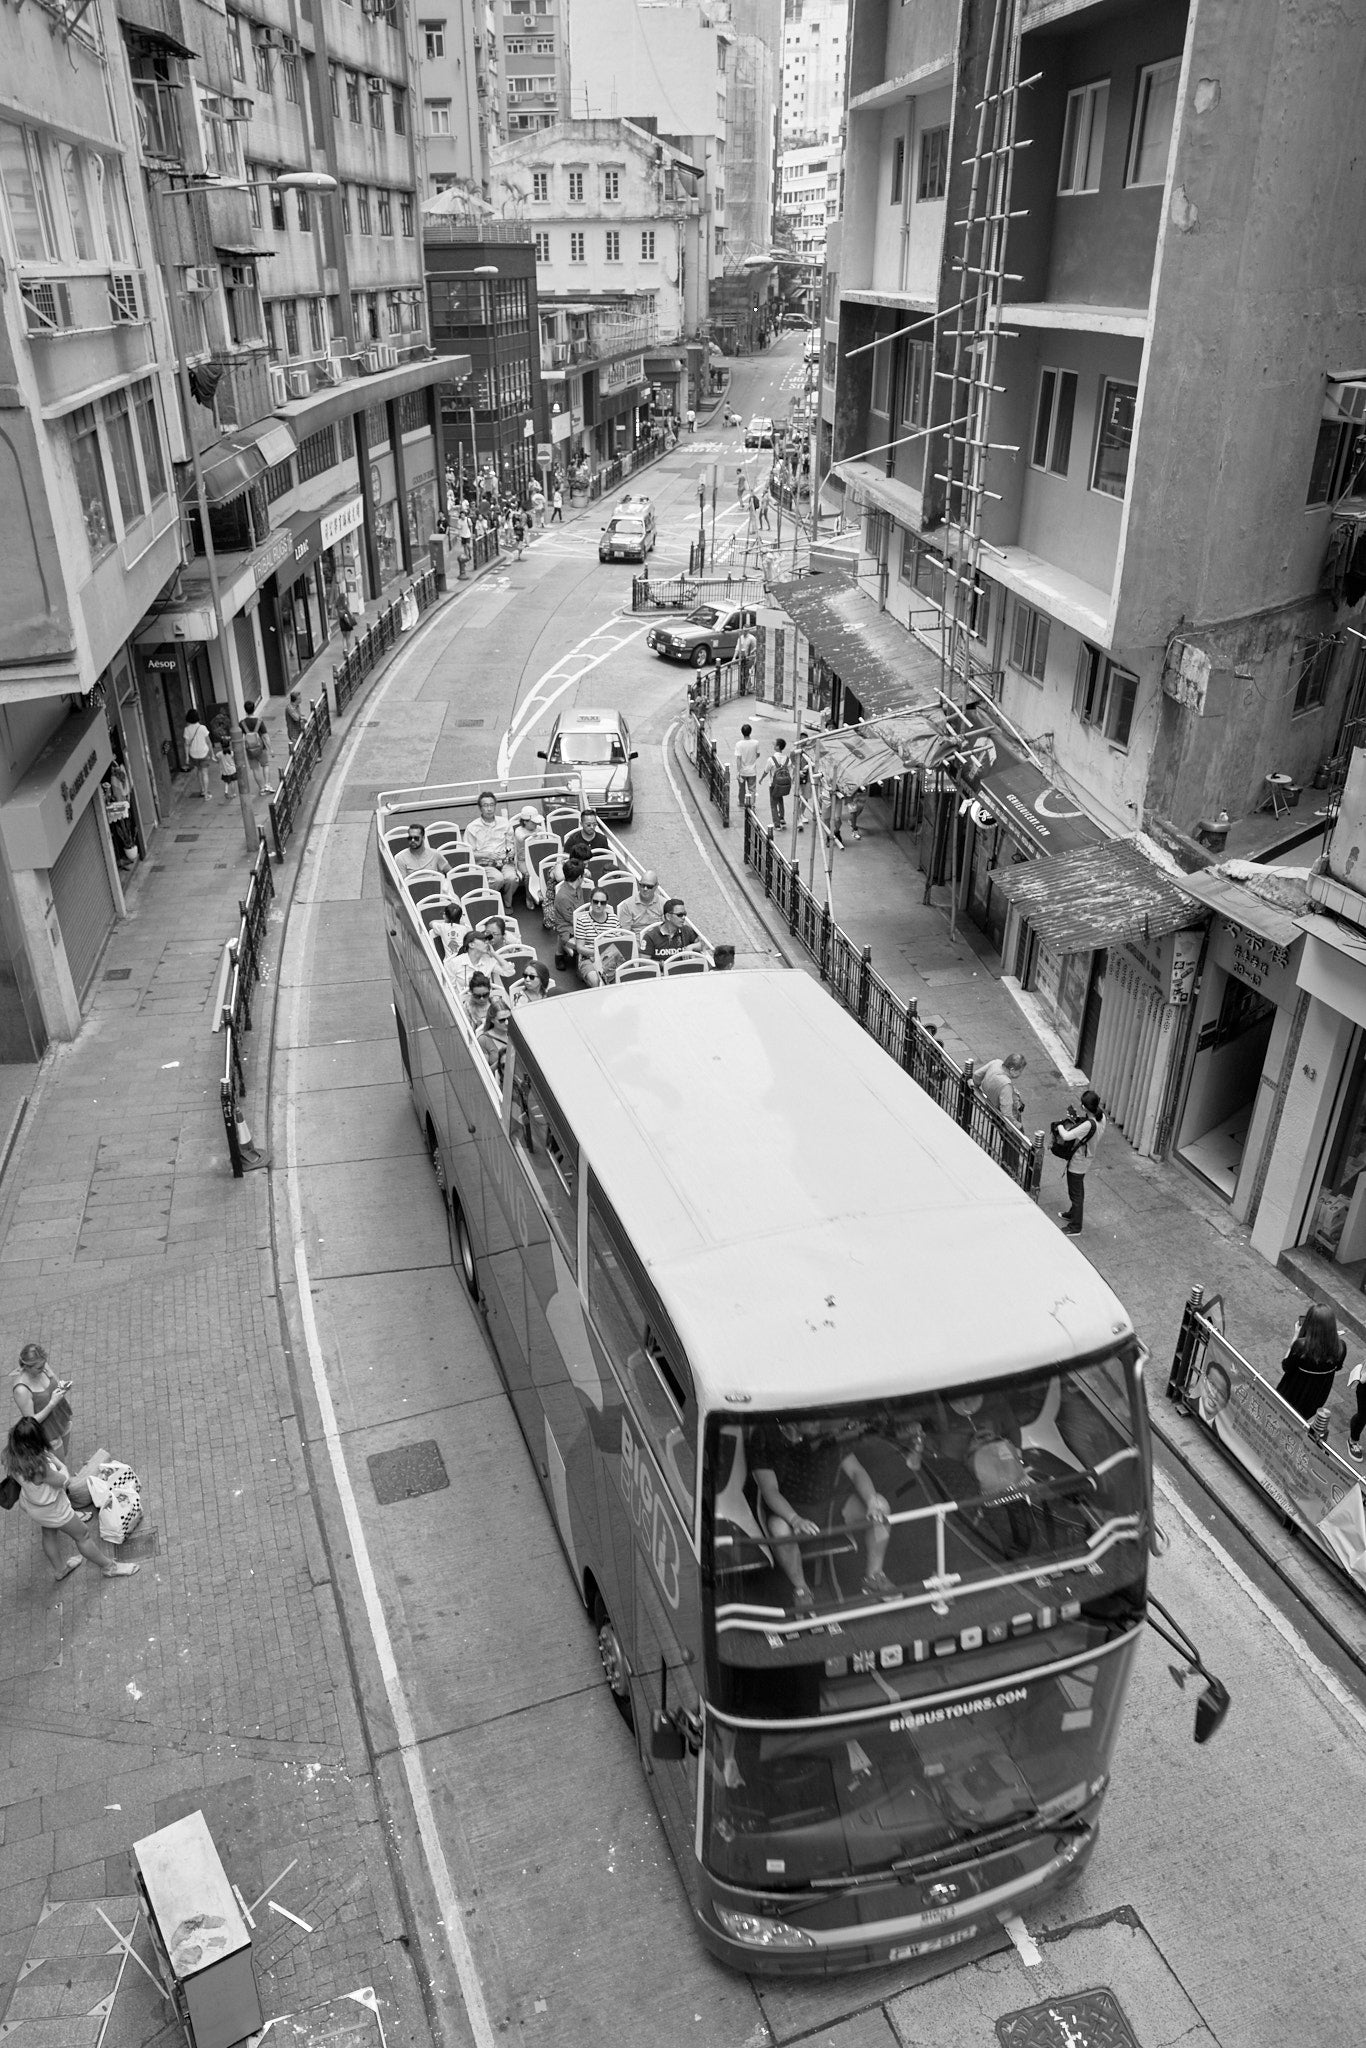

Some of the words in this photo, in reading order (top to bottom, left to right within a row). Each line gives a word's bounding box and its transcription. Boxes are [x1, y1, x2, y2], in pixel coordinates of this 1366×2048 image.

[1302, 1064, 1317, 1081] 43
[622, 1414, 654, 1514] BIG
[889, 1686, 1028, 1733] BIGBUSTOURS.COM
